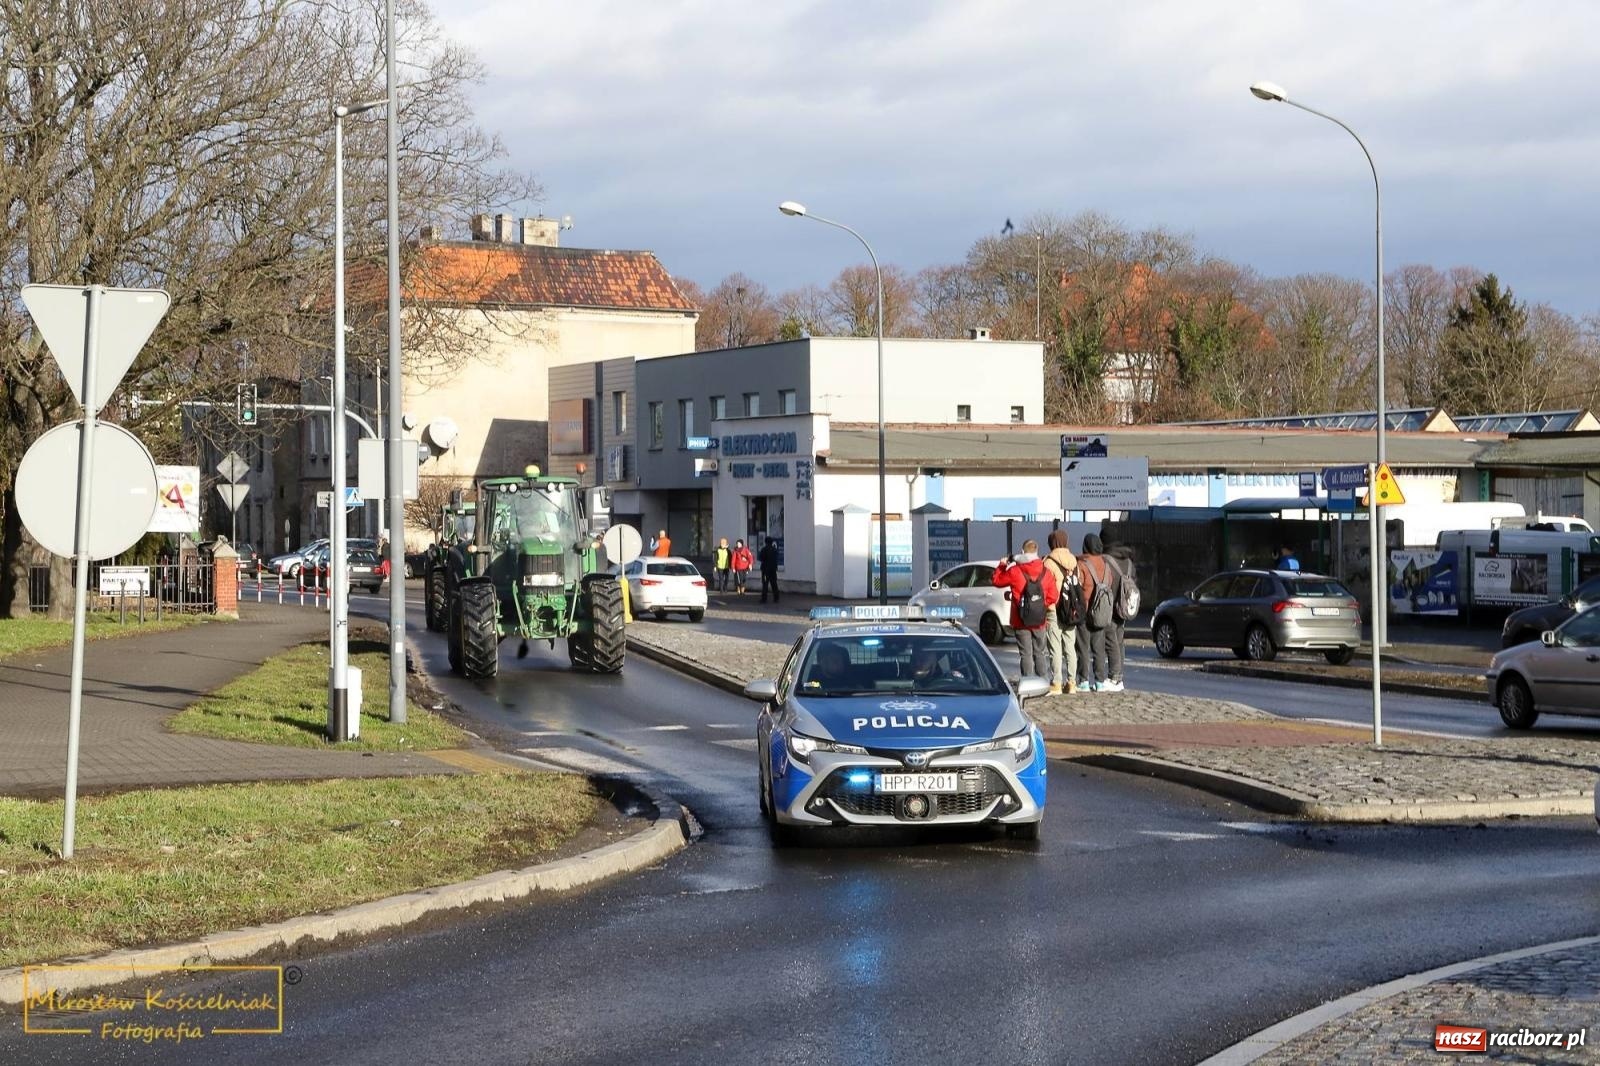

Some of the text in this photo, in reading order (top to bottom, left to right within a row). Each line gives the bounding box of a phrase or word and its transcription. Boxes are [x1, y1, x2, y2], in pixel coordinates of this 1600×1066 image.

[689, 439, 717, 449] PHILIPS
[722, 432, 797, 456] ELEKTROCOM
[733, 463, 755, 478] HURT
[763, 462, 790, 478] DETAL
[856, 607, 898, 618] POLICJA
[853, 715, 970, 731] POLICJA
[884, 773, 955, 791] HPP R201
